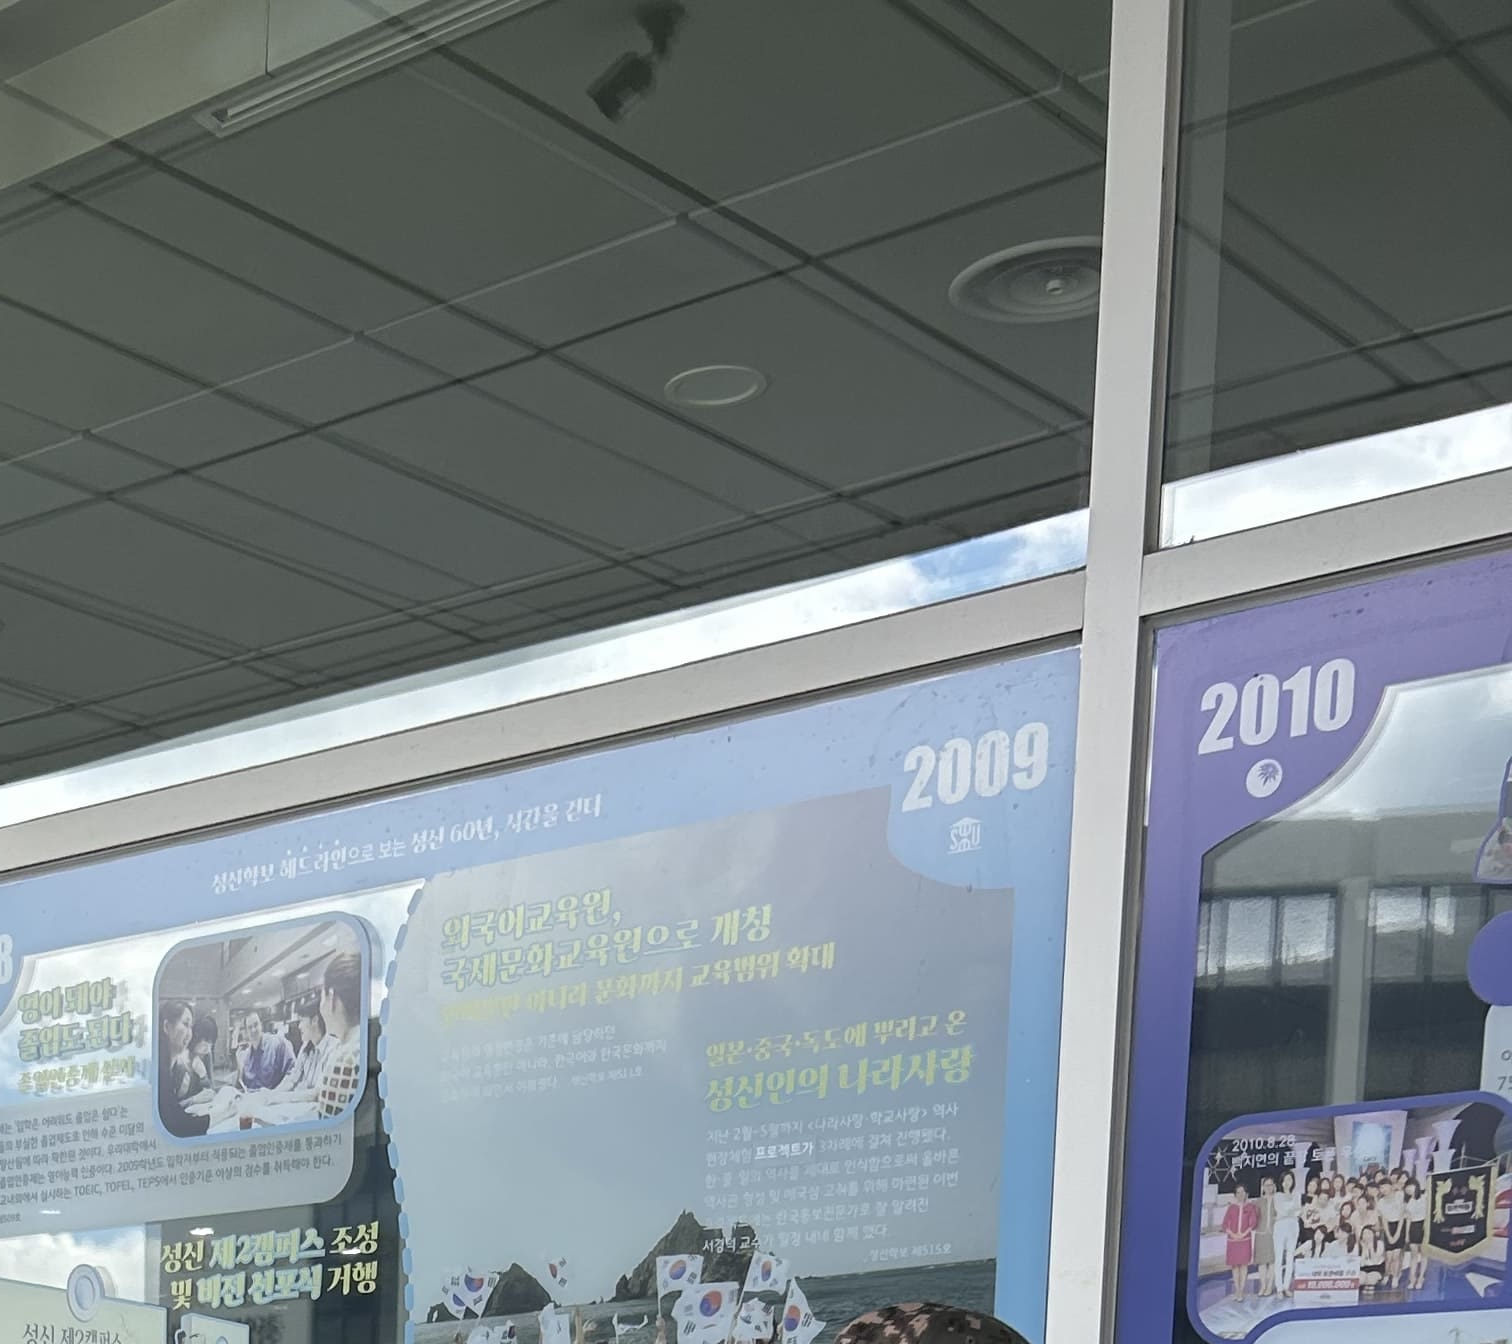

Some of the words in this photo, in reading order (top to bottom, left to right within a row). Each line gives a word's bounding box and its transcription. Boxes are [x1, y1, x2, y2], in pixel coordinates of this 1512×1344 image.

[1198, 658, 1355, 755] 2010
[901, 722, 1050, 812] 2009
[377, 839, 406, 860] 보는
[411, 826, 446, 856] 성신
[449, 814, 500, 845] 60년,
[836, 1044, 974, 1092] 나라사랑
[754, 1142, 813, 1160] 프로젝트가
[161, 1238, 204, 1274] 성신
[208, 1226, 325, 1269] 제2캠퍼스
[330, 1221, 379, 1255] 조성
[171, 1279, 192, 1310] 및
[197, 1272, 245, 1310] 비전
[248, 1265, 322, 1306] 선포식
[327, 1259, 378, 1295] 거행
